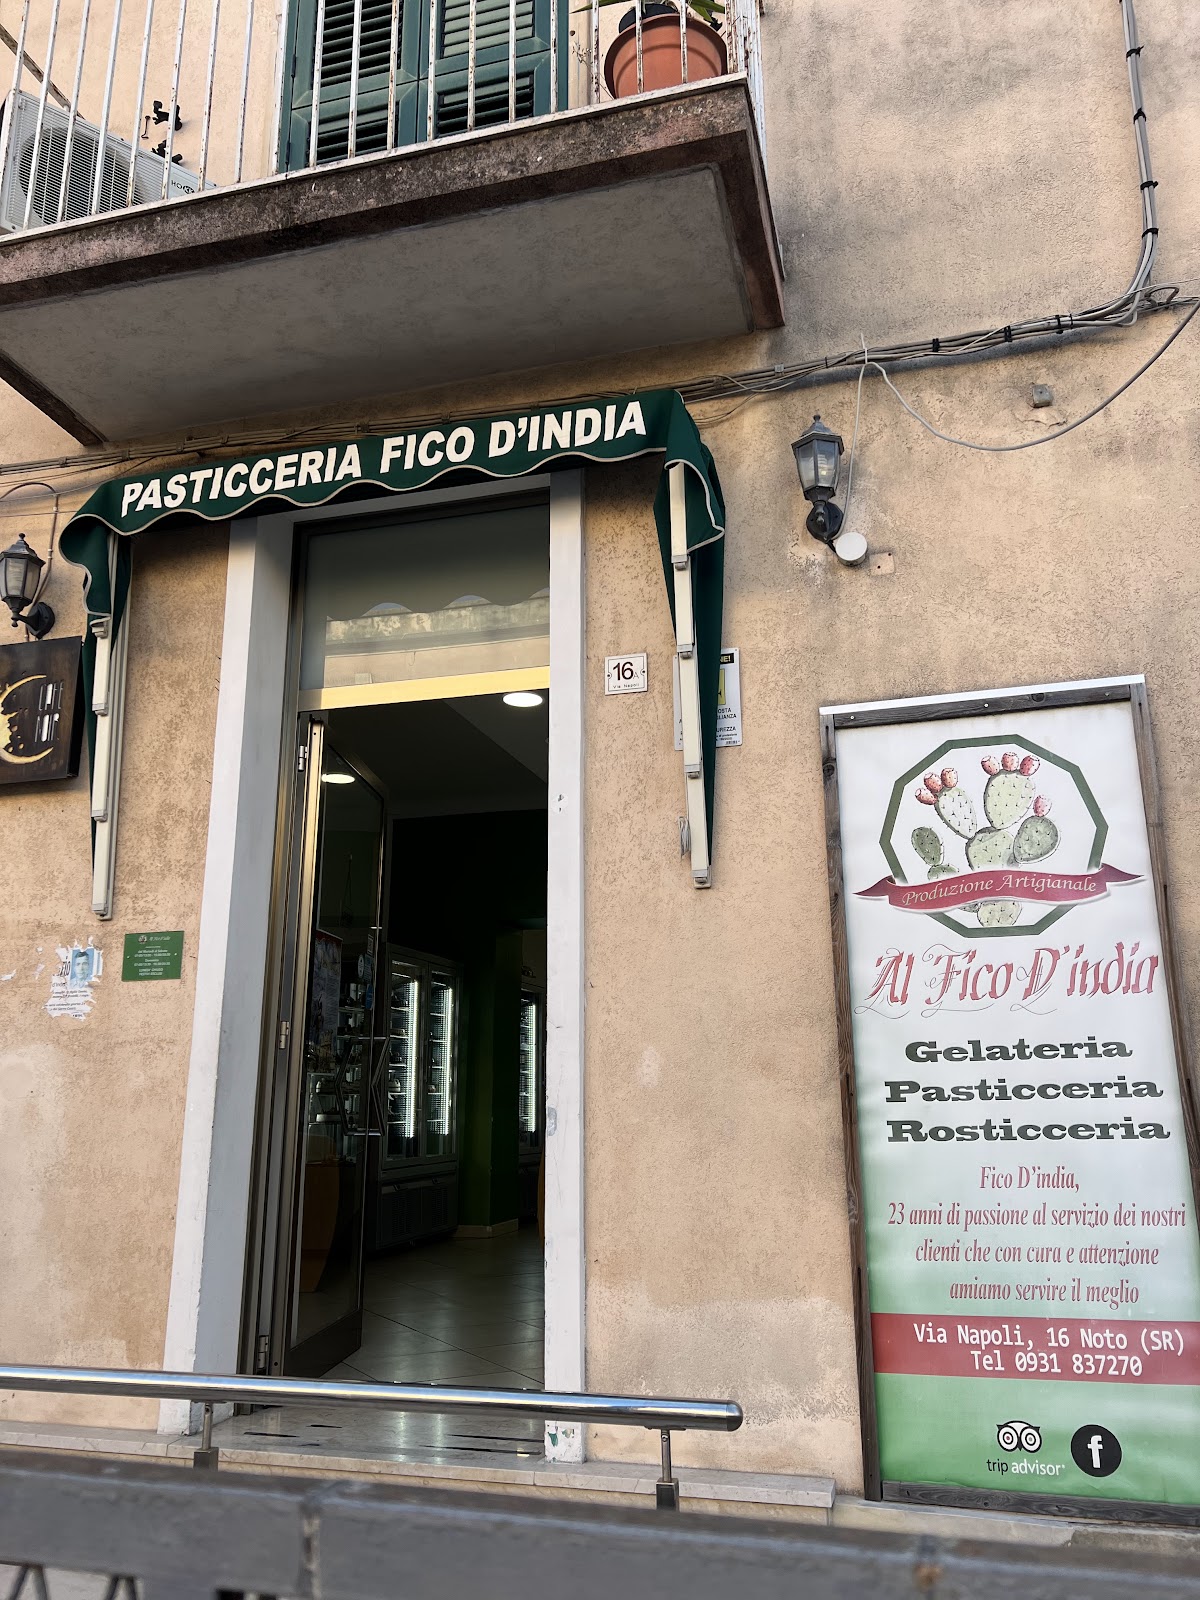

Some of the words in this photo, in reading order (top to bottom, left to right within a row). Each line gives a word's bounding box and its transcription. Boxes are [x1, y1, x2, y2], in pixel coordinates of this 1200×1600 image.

[120, 444, 362, 518] PASTICCERIA
[379, 425, 475, 474] FICO
[488, 400, 648, 458] D'INDIA
[902, 879, 993, 906] Produzione
[996, 875, 1097, 893] Artigianale
[922, 945, 1013, 1011] Fico
[904, 1036, 1133, 1063] Gelateria
[884, 1075, 1164, 1103] Pasticceria
[886, 1116, 1171, 1143] Rosticceria
[979, 1166, 1013, 1189] Fico
[887, 1202, 905, 1226] 23
[909, 1203, 942, 1226] anni
[946, 1203, 960, 1226] di
[963, 1203, 1029, 1232] passione
[1032, 1203, 1047, 1226] al
[1051, 1203, 1109, 1229] servizio
[1113, 1203, 1137, 1227] dei
[1141, 1203, 1186, 1228] nostri
[915, 1238, 960, 1262] clienti
[964, 1239, 990, 1263] che
[994, 1244, 1022, 1263] con
[1026, 1244, 1062, 1264] cura
[1066, 1245, 1075, 1264] e
[1078, 1241, 1160, 1267] attenzione
[949, 1276, 1011, 1301] amiamo
[1015, 1277, 1067, 1302] servire
[1071, 1277, 1082, 1303] il
[1086, 1278, 1139, 1311] meglio
[913, 1322, 948, 1343] Via
[957, 1324, 1034, 1350] Napoli,
[1046, 1327, 1070, 1348] 16
[1080, 1329, 1127, 1350] Noto
[1140, 1329, 1185, 1356] (SR)
[971, 1350, 1005, 1372] Tel
[1015, 1352, 1061, 1373] 0931
[1072, 1353, 1143, 1377] 837270
